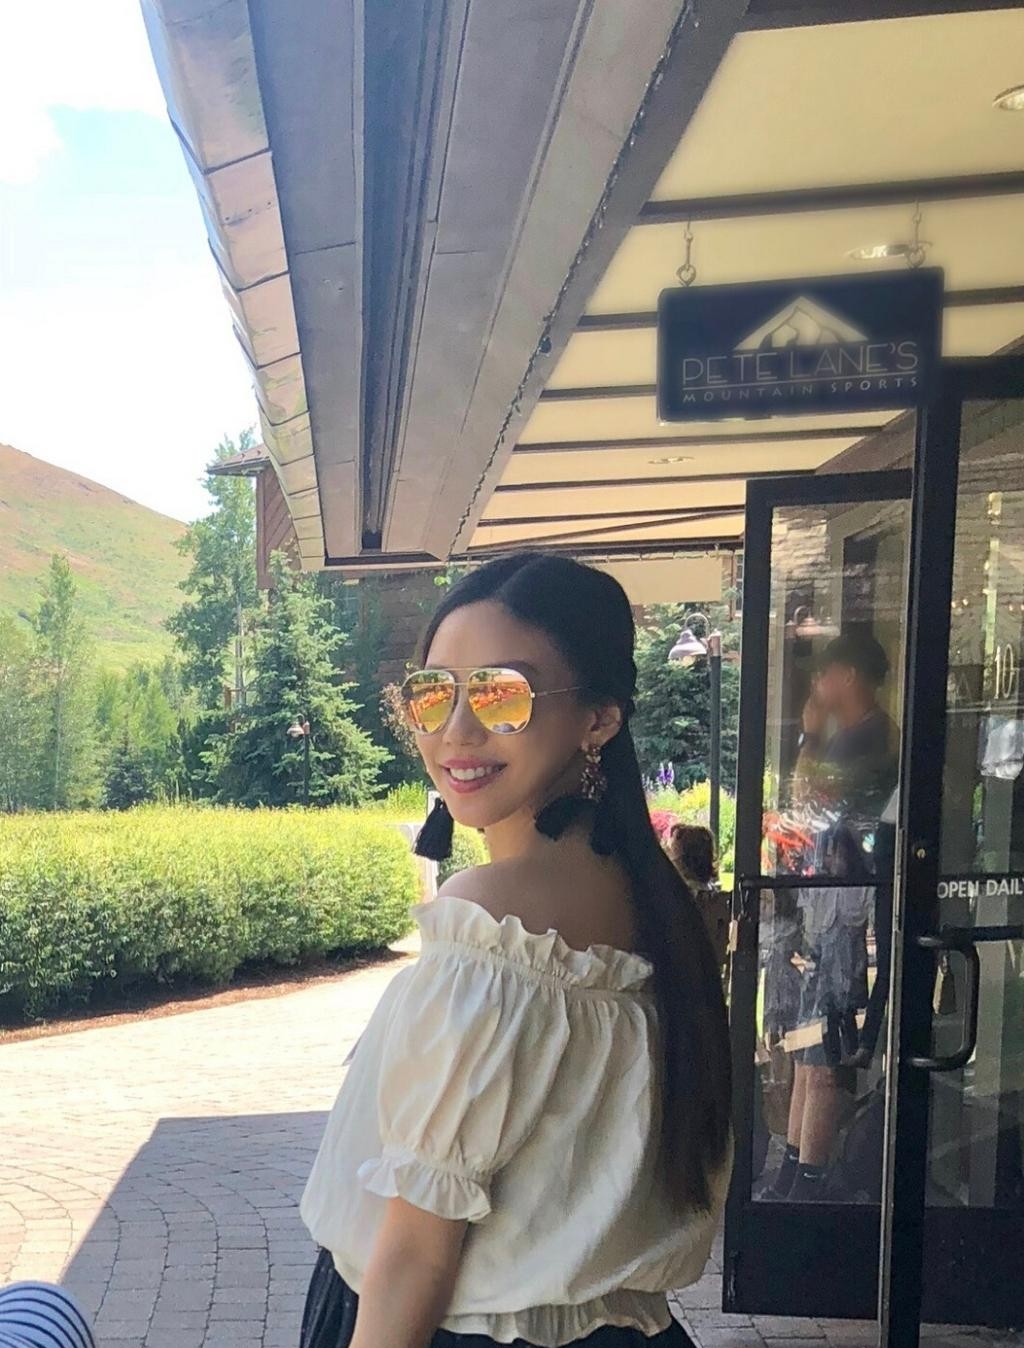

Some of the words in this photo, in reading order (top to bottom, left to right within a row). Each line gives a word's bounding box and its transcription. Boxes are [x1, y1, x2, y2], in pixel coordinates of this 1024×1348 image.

[681, 351, 778, 385] PETE
[789, 341, 919, 378] LANE'S
[682, 384, 814, 403] MOUNTAIN
[830, 376, 918, 393] SPORTS
[937, 880, 980, 899] OPEN
[986, 877, 1024, 897] DAIL
